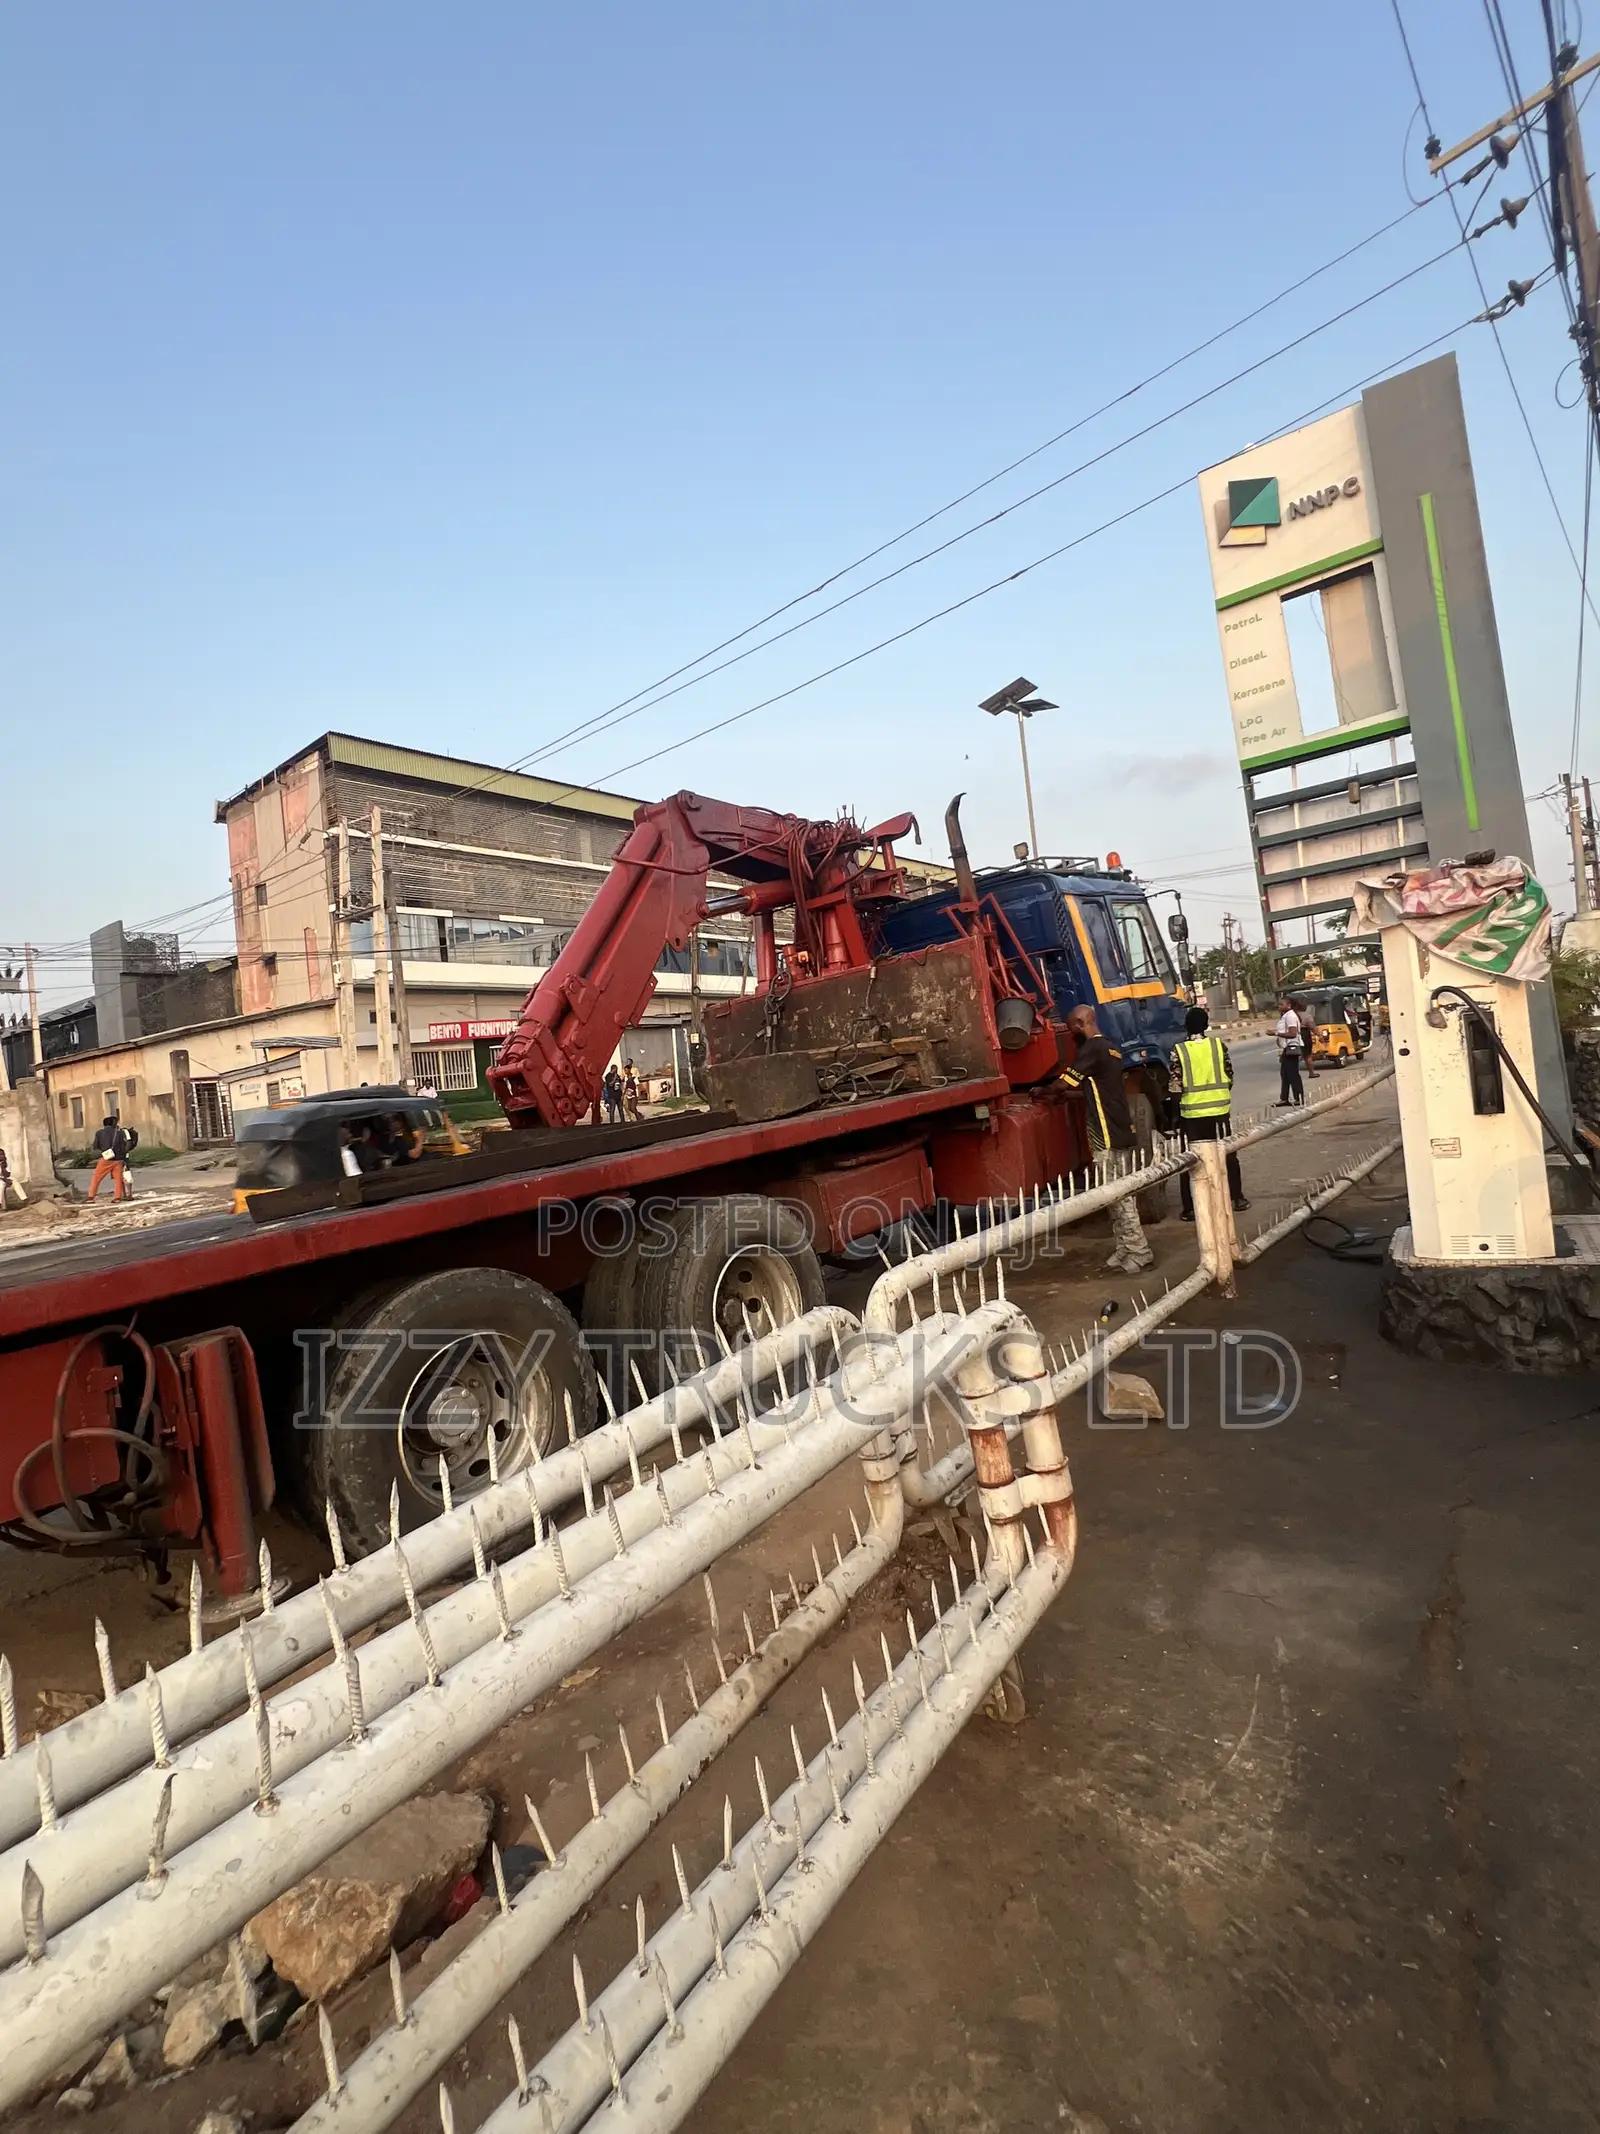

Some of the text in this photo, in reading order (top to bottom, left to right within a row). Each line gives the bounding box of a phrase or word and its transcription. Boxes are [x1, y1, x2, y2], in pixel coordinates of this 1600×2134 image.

[1288, 477, 1360, 520] NNPC
[1233, 678, 1286, 701] Kerosene
[1239, 715, 1263, 730] LPG
[1241, 732, 1267, 747] Free
[430, 1024, 462, 1040] BENTO
